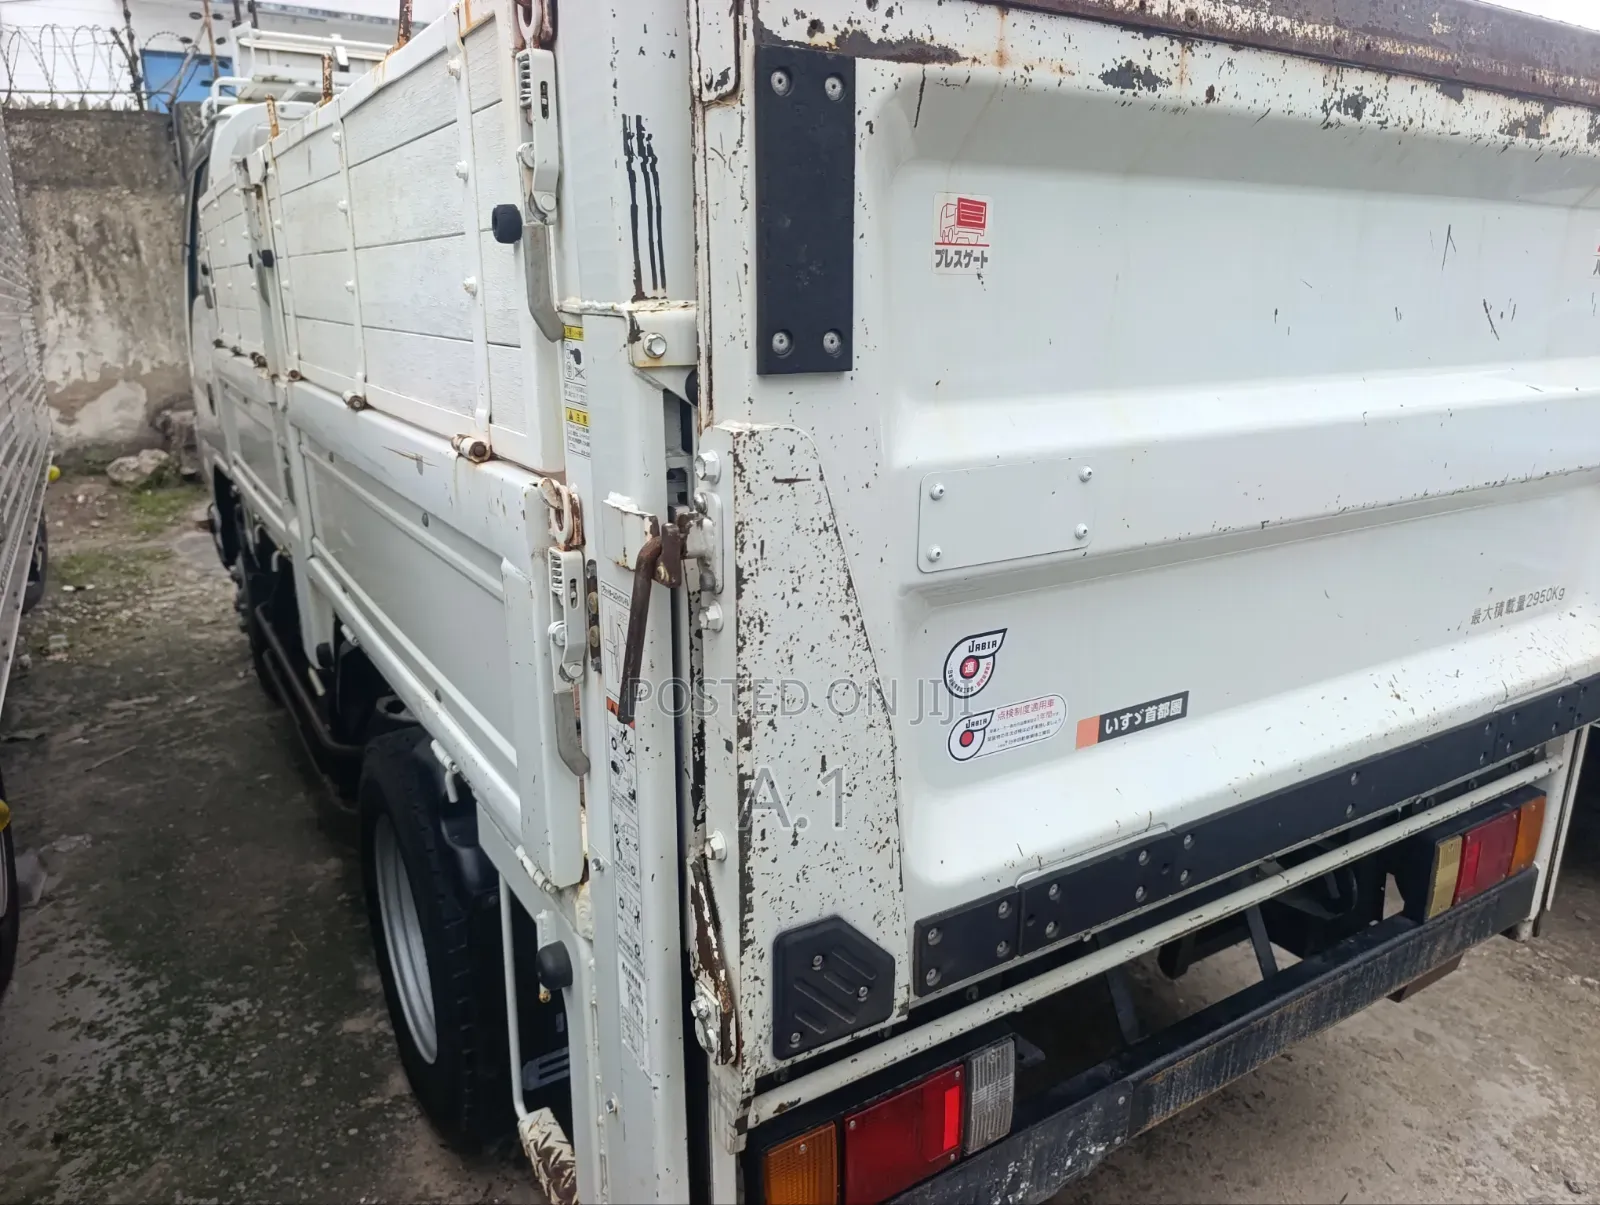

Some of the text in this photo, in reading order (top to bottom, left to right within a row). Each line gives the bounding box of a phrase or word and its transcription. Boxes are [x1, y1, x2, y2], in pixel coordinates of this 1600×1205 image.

[934, 248, 989, 269] プレスゲート
[1470, 584, 1566, 626] 最大積載量2950Kg
[968, 639, 998, 654] JABIA
